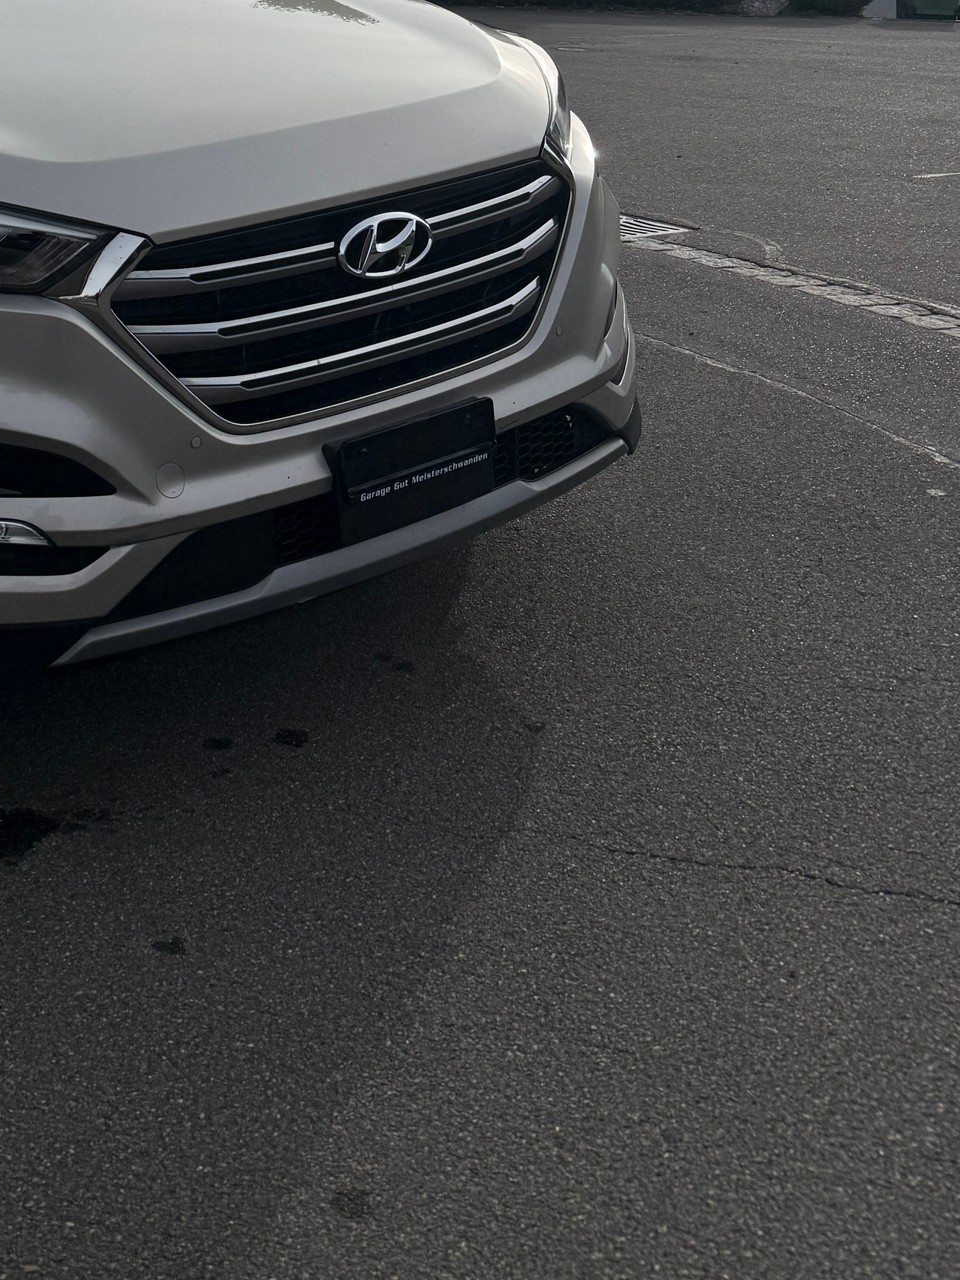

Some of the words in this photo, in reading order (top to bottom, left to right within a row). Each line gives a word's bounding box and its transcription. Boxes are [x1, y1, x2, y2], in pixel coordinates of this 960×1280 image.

[360, 486, 391, 502] Garage
[393, 479, 409, 491] Gut
[411, 452, 488, 484] Meisterschwanden
